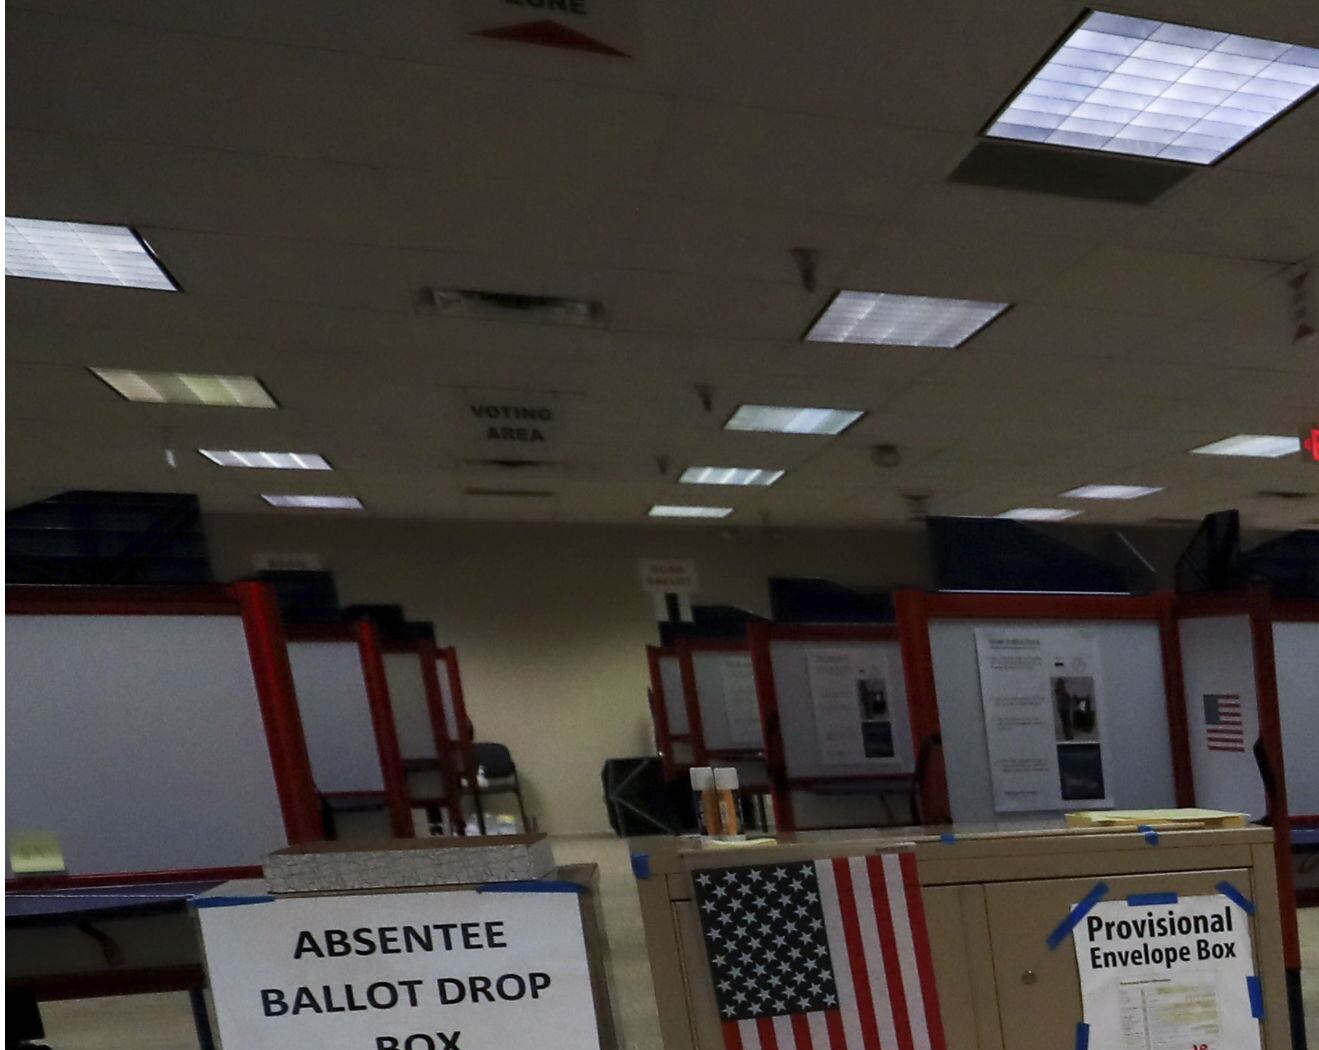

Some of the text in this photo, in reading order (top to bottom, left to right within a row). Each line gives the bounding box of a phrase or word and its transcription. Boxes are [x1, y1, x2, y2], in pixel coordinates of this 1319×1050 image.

[470, 404, 553, 423] VOTING
[487, 426, 545, 442] AREA
[1087, 906, 1233, 941] Provisional
[293, 921, 508, 960] ABSENTEE
[1090, 939, 1236, 969] Envelope Box
[260, 972, 552, 1017] BALLOT DROP
